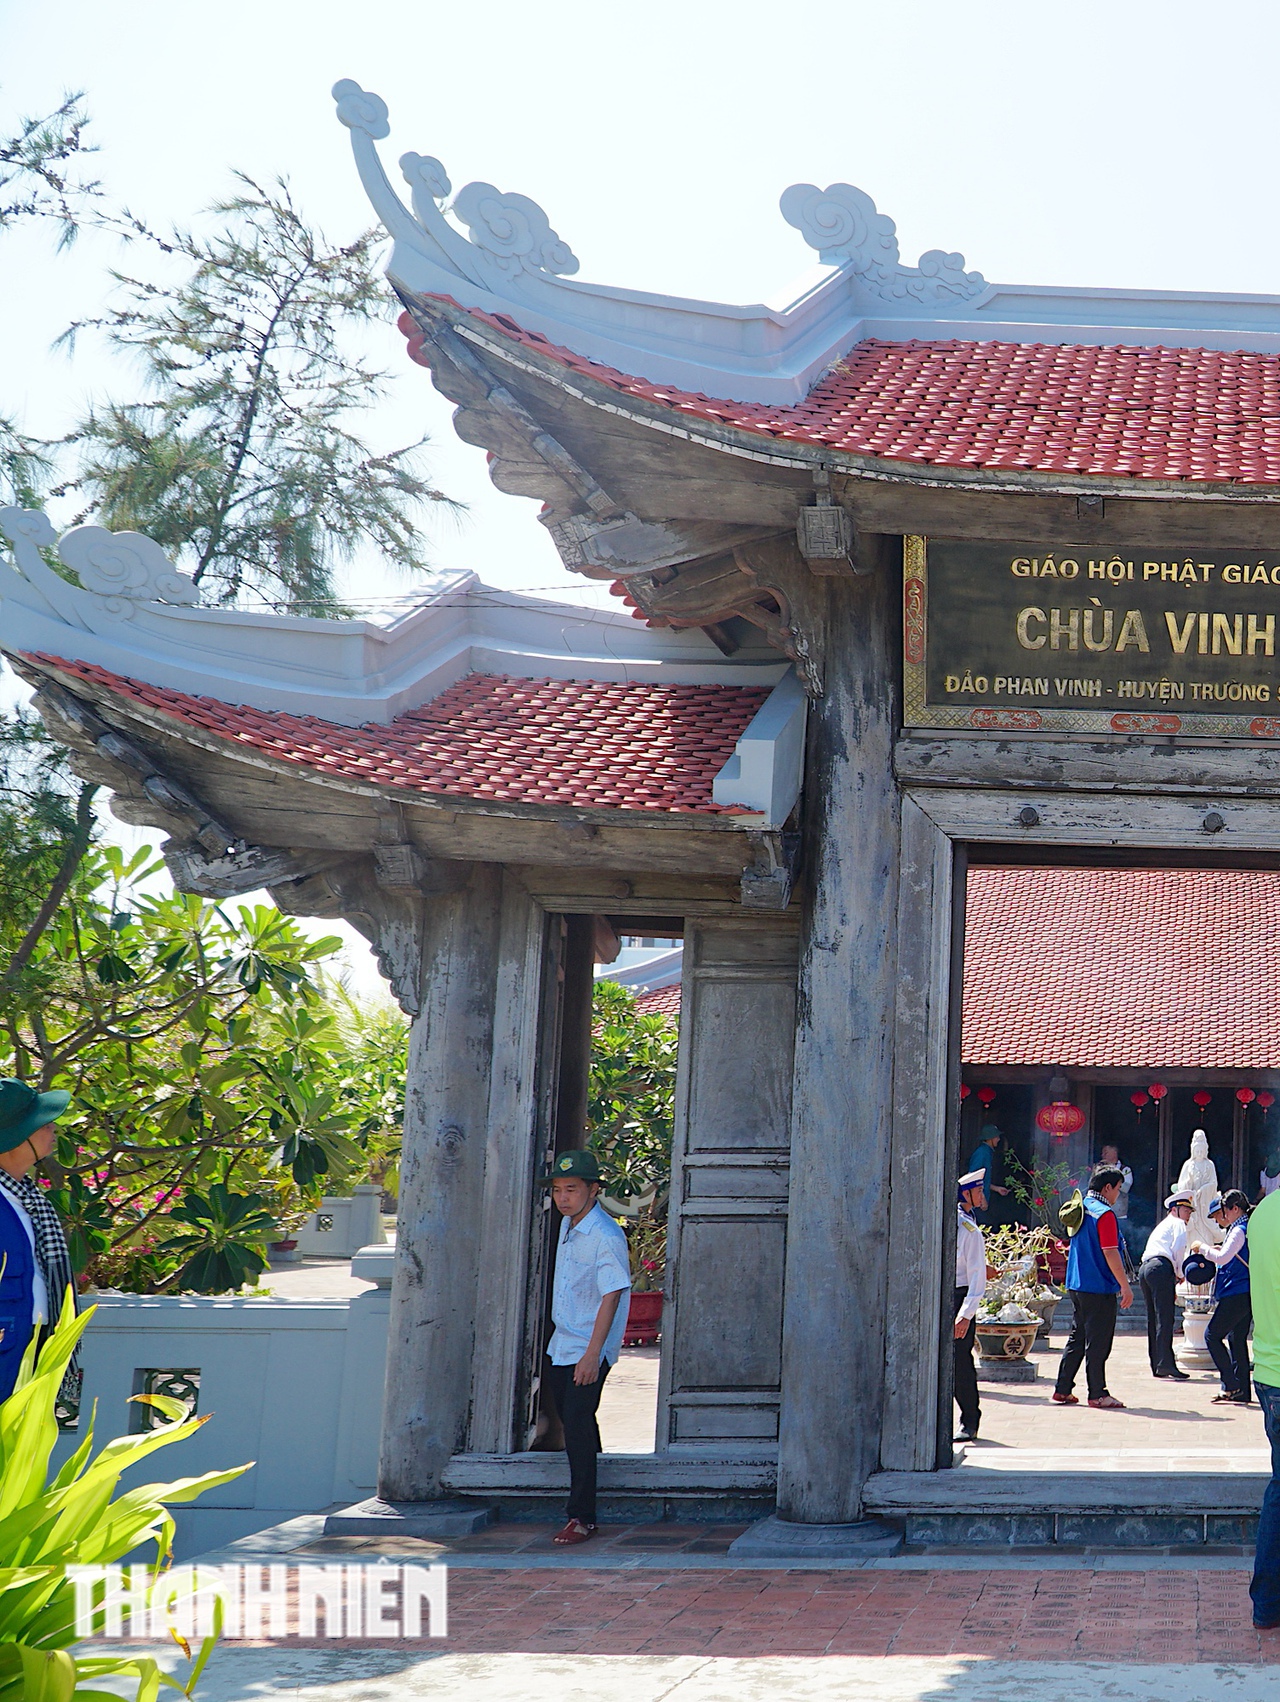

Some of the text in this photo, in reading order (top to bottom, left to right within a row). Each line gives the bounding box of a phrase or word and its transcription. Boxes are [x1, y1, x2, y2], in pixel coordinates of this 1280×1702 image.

[1011, 552, 1079, 579] GIÁO
[1088, 555, 1134, 586] HỘI
[1143, 558, 1215, 588] PHẬT
[1016, 596, 1150, 653] CHÙA
[1164, 611, 1275, 656] VINH
[945, 669, 989, 695] ĐẢO
[994, 676, 1049, 696] PHAN
[1054, 678, 1102, 698] VINH
[1117, 677, 1185, 704] HUYỆN
[1190, 679, 1270, 702] TRƯỜNG
